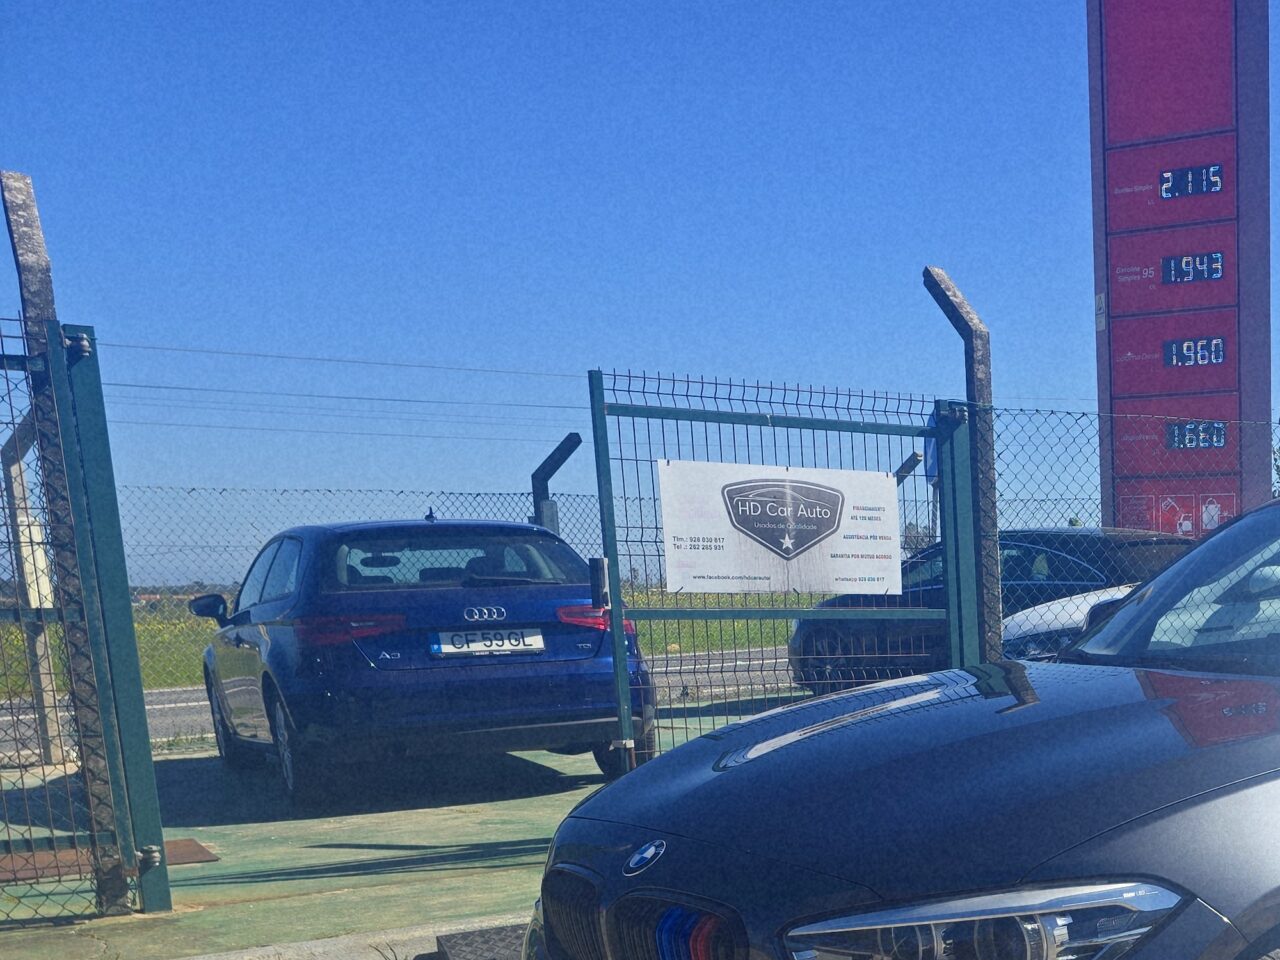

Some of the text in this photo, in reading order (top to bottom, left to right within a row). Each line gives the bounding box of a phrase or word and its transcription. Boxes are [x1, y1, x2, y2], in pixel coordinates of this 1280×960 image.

[1161, 165, 1221, 198] 2.115
[1142, 267, 1155, 279] 95
[1171, 253, 1222, 282] 1.943
[1172, 338, 1224, 366] 1.960
[738, 501, 762, 516] HD
[766, 502, 793, 517] Car
[797, 503, 831, 519] Auto
[451, 630, 534, 650] CF 59 GL
[379, 651, 401, 660] A3
